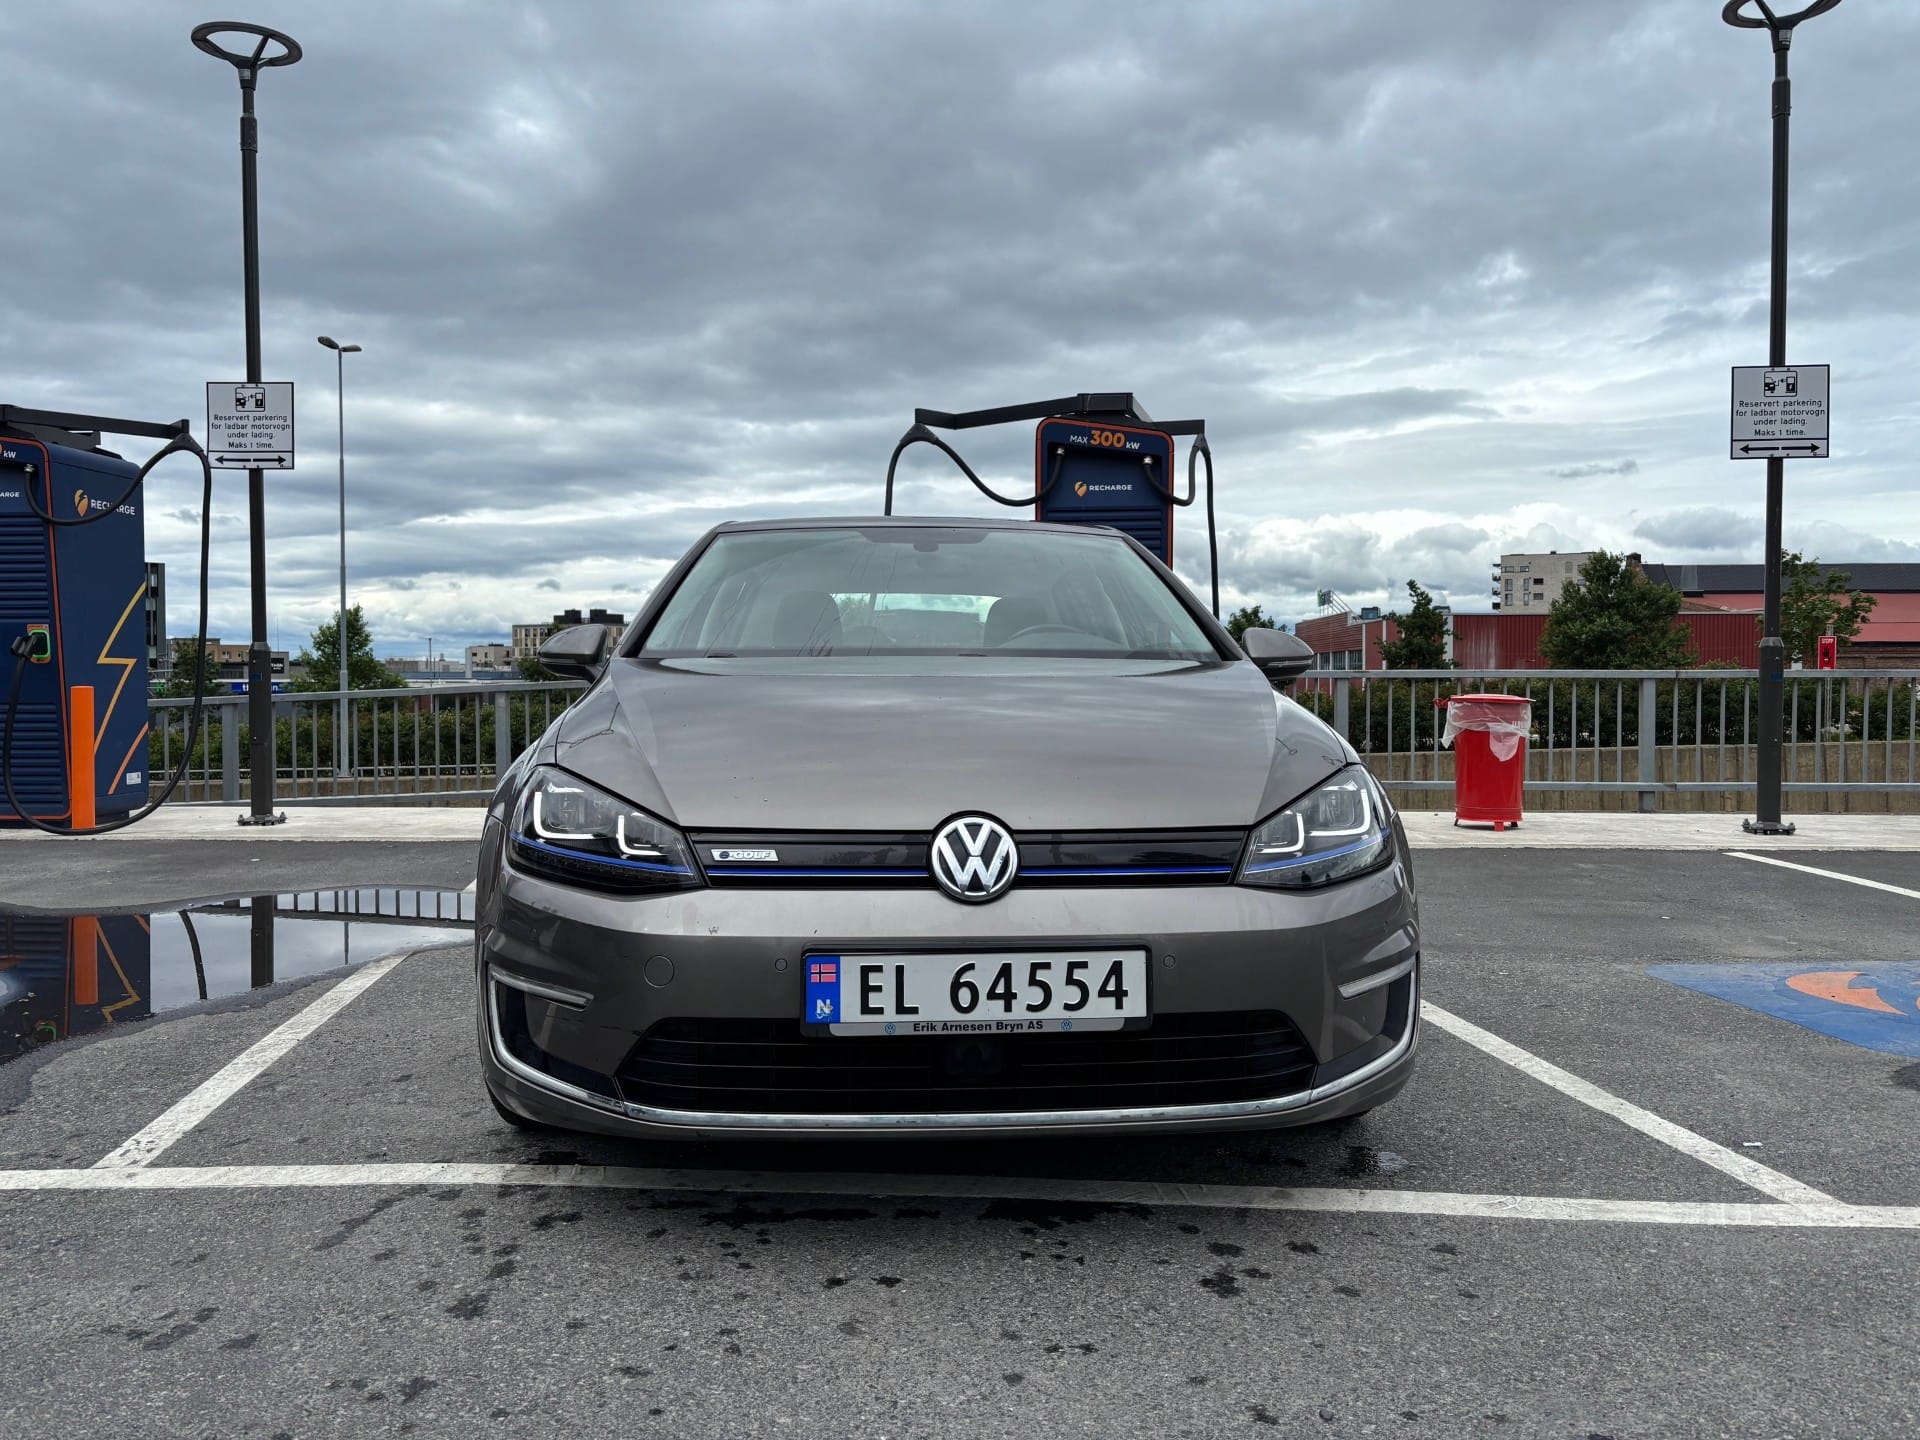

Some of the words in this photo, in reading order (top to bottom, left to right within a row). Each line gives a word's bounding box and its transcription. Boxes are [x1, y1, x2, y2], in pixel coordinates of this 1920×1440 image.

[1783, 399, 1822, 408] parkering
[1736, 409, 1747, 417] for
[1780, 408, 1825, 417] motorvogn
[213, 413, 250, 421] Reservert
[253, 414, 287, 422] parkering
[1780, 417, 1808, 426] lading.
[211, 422, 221, 430] for
[224, 422, 248, 430] ladbar
[251, 423, 290, 431] motorvogn
[1754, 429, 1775, 437] Maks
[1786, 428, 1806, 436] time.
[1069, 435, 1088, 444] MAX
[1090, 430, 1126, 448] 300
[1126, 441, 1140, 450] kW
[228, 441, 247, 449] Maks
[256, 441, 274, 449] time.
[3, 450, 17, 459] kW
[90, 499, 136, 515] RECRGE
[859, 963, 919, 1016] EL
[949, 959, 1129, 1015] 64554
[913, 1022, 937, 1032] Erik
[941, 1022, 992, 1032] Arnesen
[996, 1021, 1023, 1032] Bryn
[1027, 1020, 1043, 1030] AS
